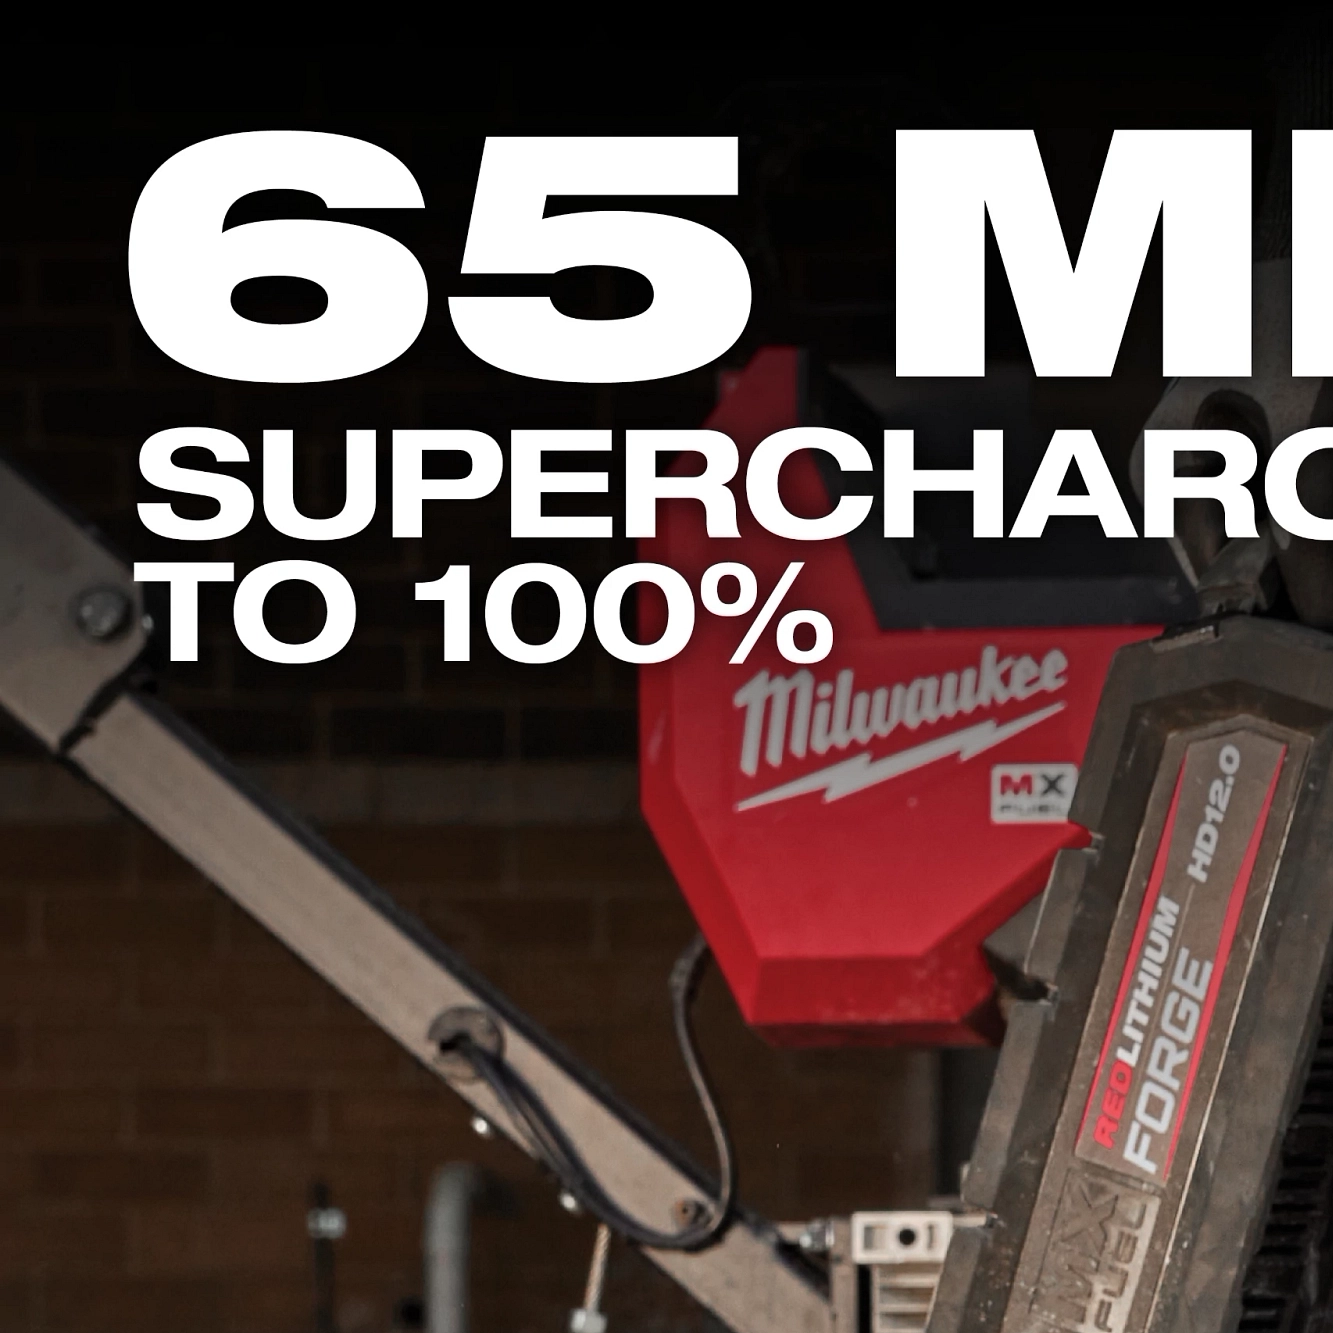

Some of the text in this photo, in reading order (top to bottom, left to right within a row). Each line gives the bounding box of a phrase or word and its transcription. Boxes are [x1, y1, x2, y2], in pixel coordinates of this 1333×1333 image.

[733, 645, 1068, 777] Milwaukee
[1000, 774, 1064, 795] MX
[1187, 744, 1241, 883] HD12.0
[1123, 946, 1213, 1175] FORGE
